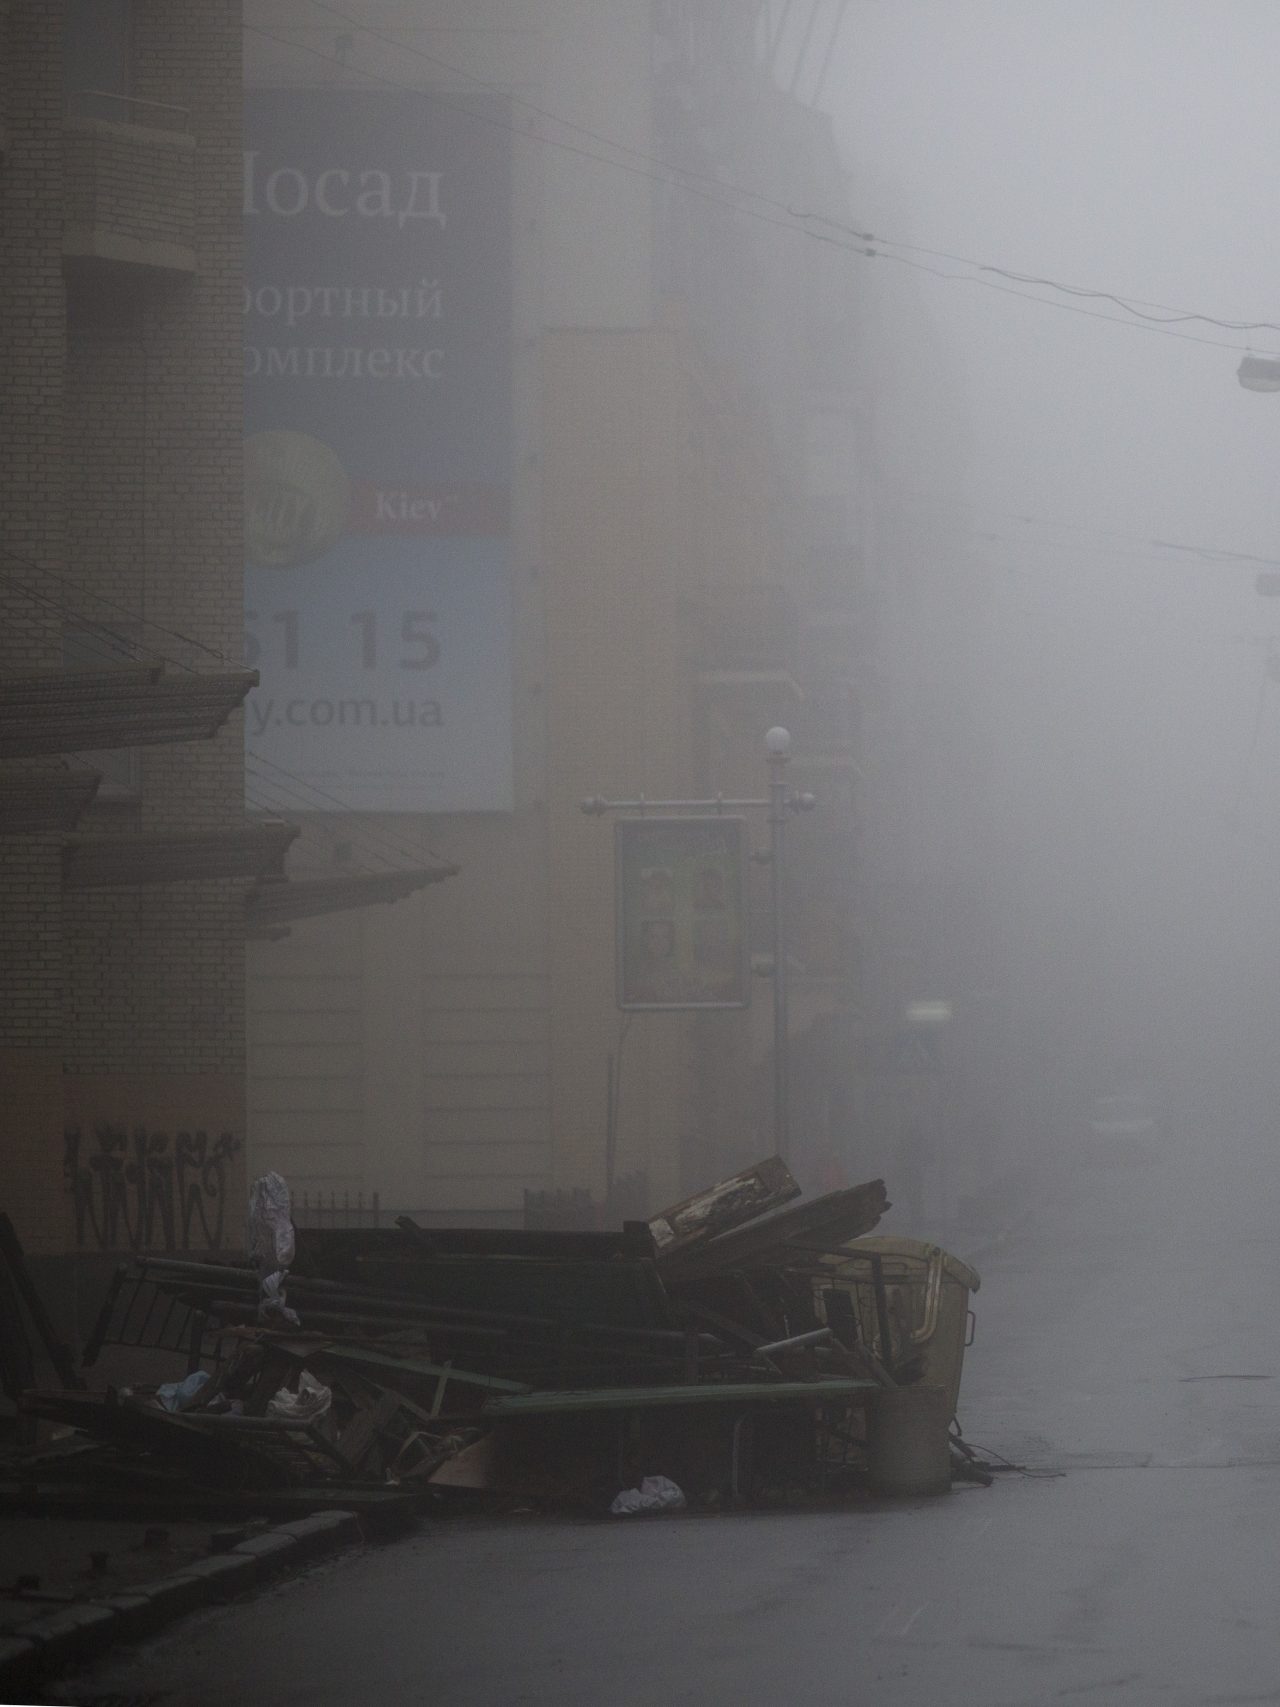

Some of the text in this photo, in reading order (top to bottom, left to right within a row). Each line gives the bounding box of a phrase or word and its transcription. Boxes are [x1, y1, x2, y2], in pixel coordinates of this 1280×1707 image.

[243, 277, 443, 326] ортный
[351, 610, 442, 671] 15
[250, 698, 445, 737] y.com.ua
